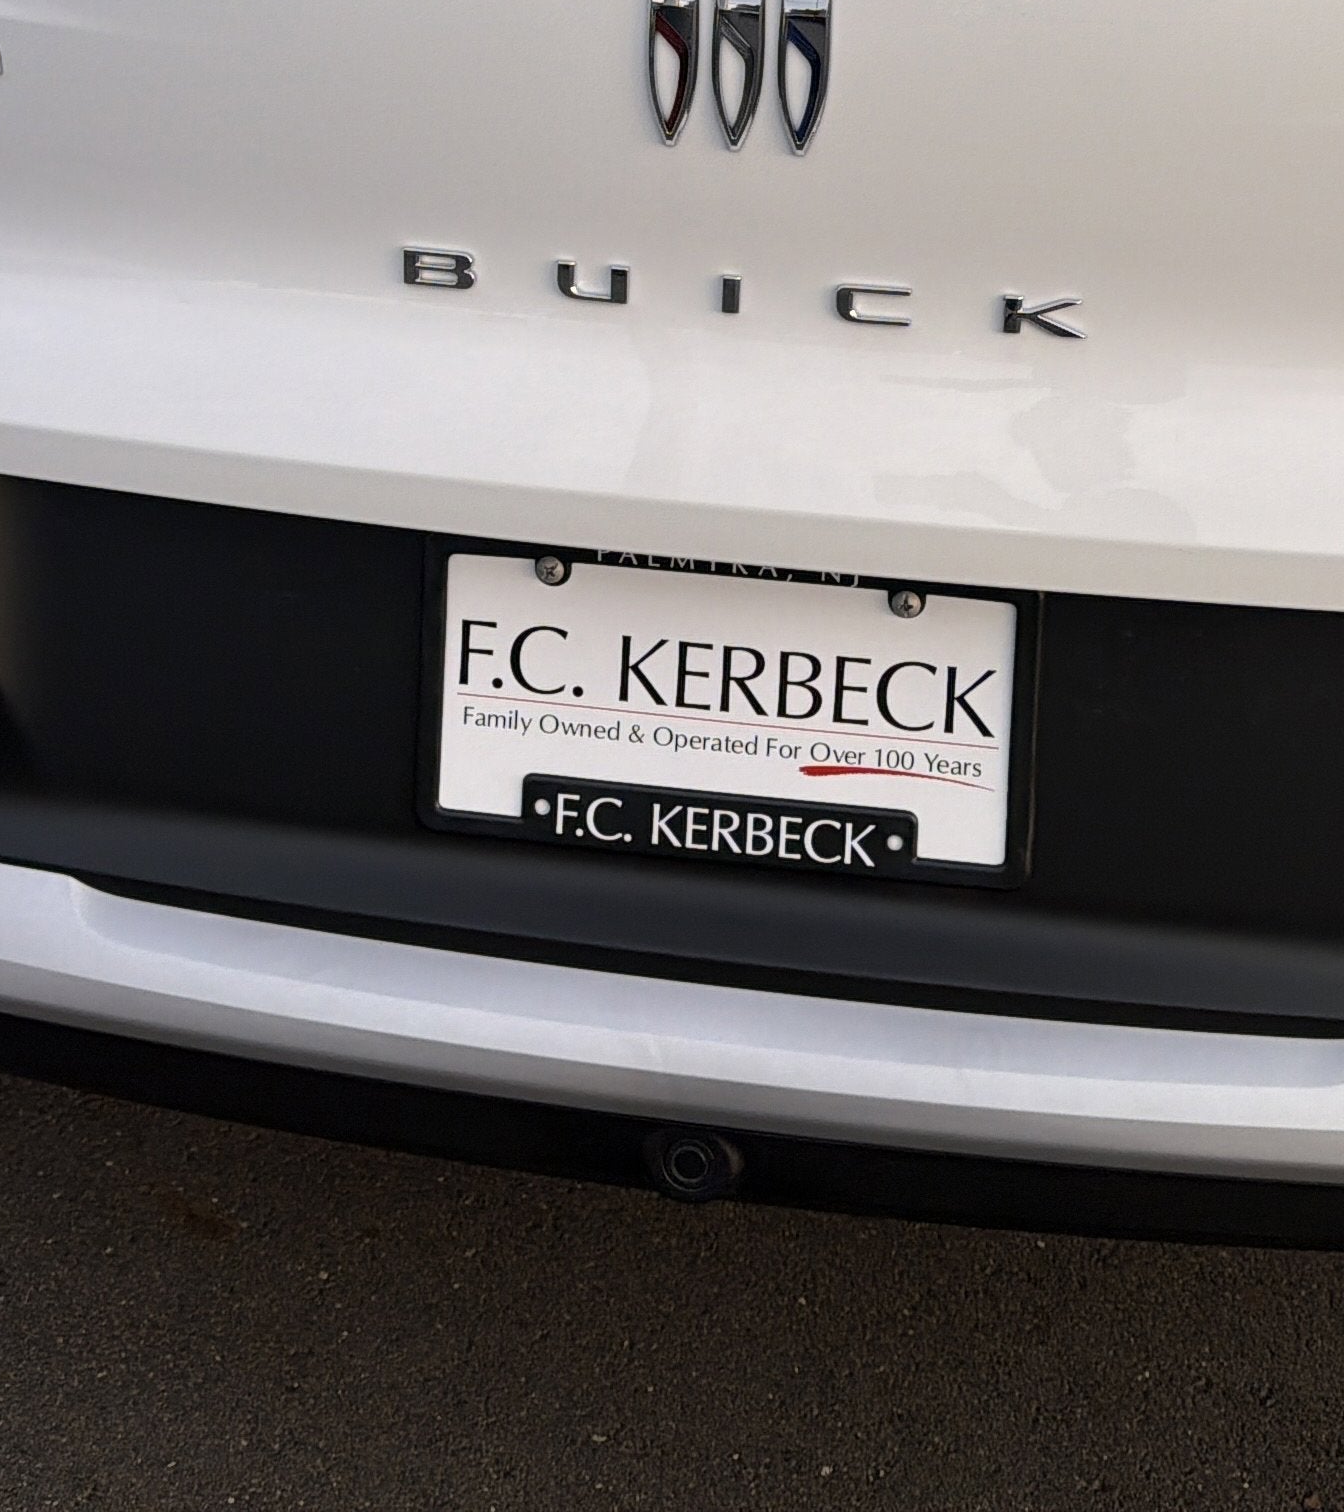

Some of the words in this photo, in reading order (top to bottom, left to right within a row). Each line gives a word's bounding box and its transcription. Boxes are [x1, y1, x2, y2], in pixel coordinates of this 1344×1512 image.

[403, 246, 1087, 340] BUICK
[458, 619, 584, 698] F.C.
[618, 635, 998, 739] KERBECK
[462, 706, 532, 737] Family
[539, 713, 620, 743] Owned
[628, 724, 645, 744] &
[653, 726, 759, 758] Operated
[766, 738, 802, 761] For
[810, 742, 867, 767] Over
[874, 749, 916, 771] 100
[924, 753, 983, 779] Years
[556, 793, 633, 843] F.C.
[651, 803, 877, 868] KERBECK
